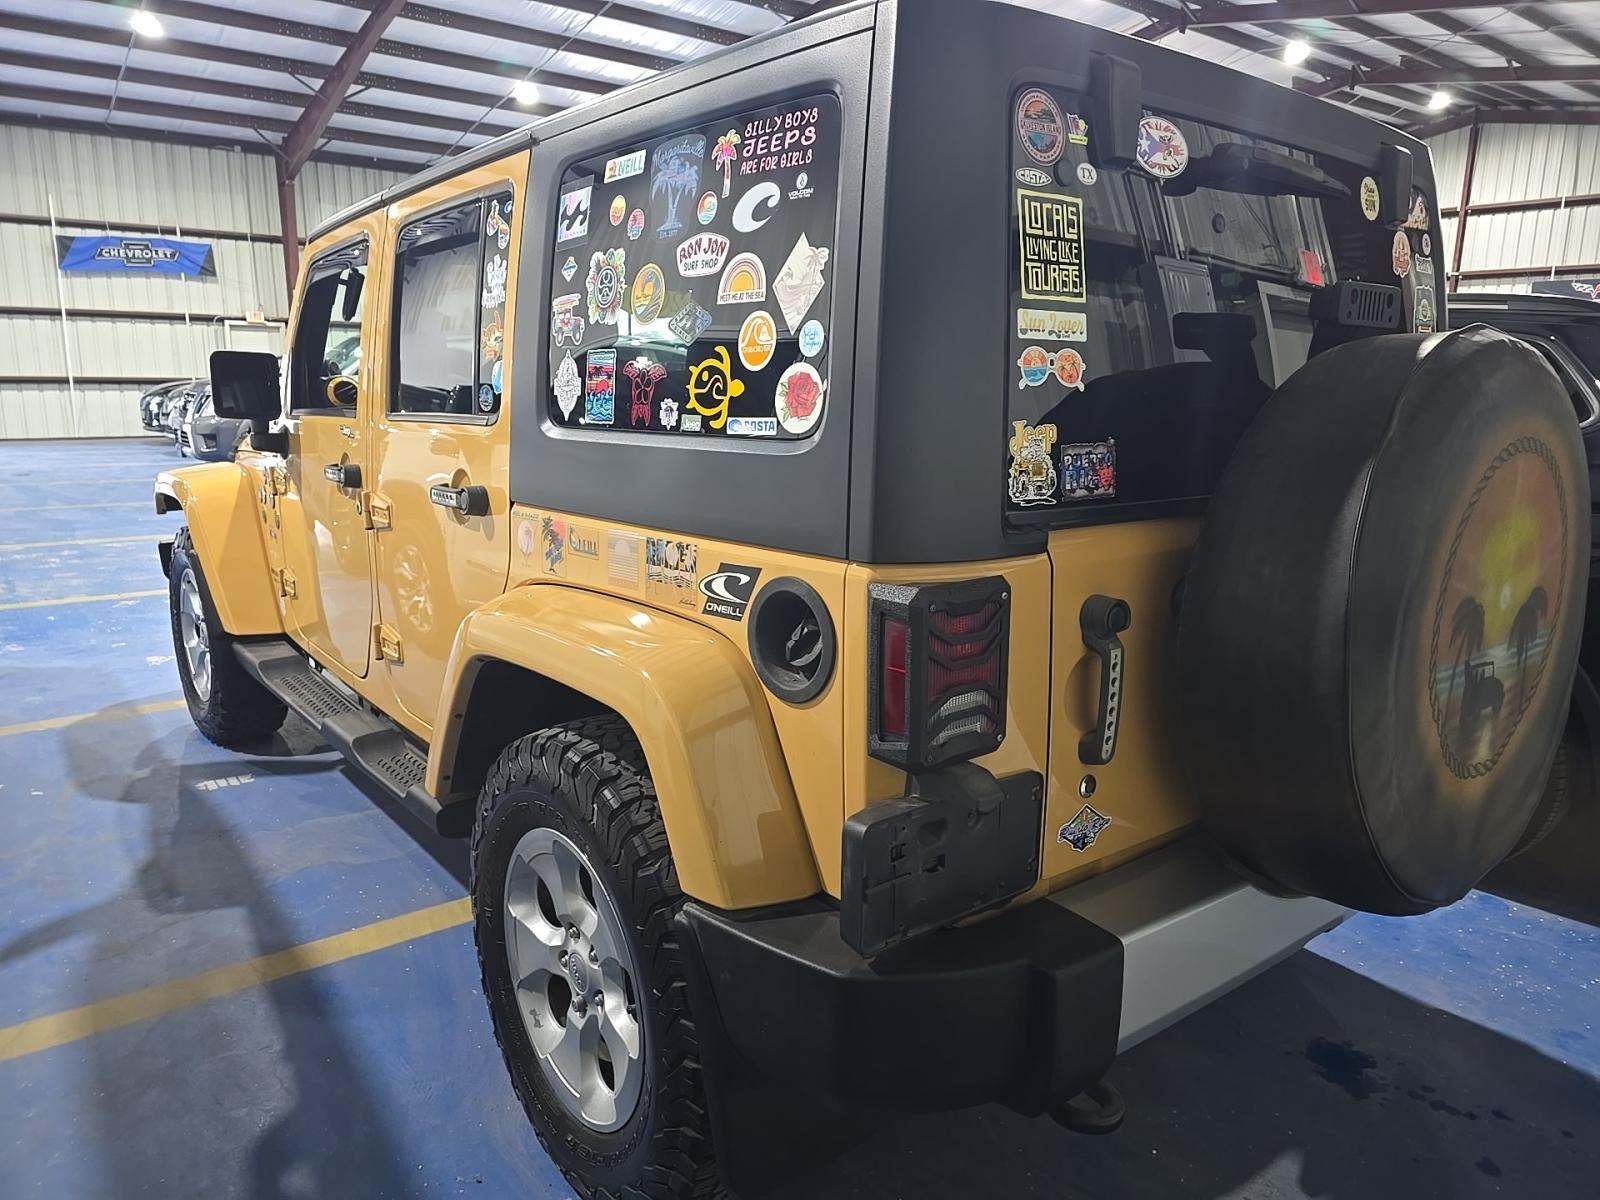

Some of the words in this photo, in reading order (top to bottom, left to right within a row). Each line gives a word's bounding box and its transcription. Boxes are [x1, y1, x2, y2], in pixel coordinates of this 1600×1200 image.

[784, 107, 819, 129] BOYS
[742, 126, 817, 158] JEEPS
[739, 158, 758, 176] ARE
[759, 155, 779, 172] FOR
[780, 148, 813, 169] GIRLS
[1017, 168, 1051, 185] COSTA
[1024, 199, 1078, 239] LOCALS
[101, 248, 173, 260] CHEVROLET
[679, 237, 702, 264] RON
[702, 237, 728, 258] JON
[1025, 236, 1057, 262] LIVING
[1057, 240, 1080, 264] LIKE
[683, 259, 698, 272] SURF
[700, 257, 719, 269] SHOP
[1010, 420, 1057, 457] Jeep
[705, 601, 743, 617] O'NEILL
